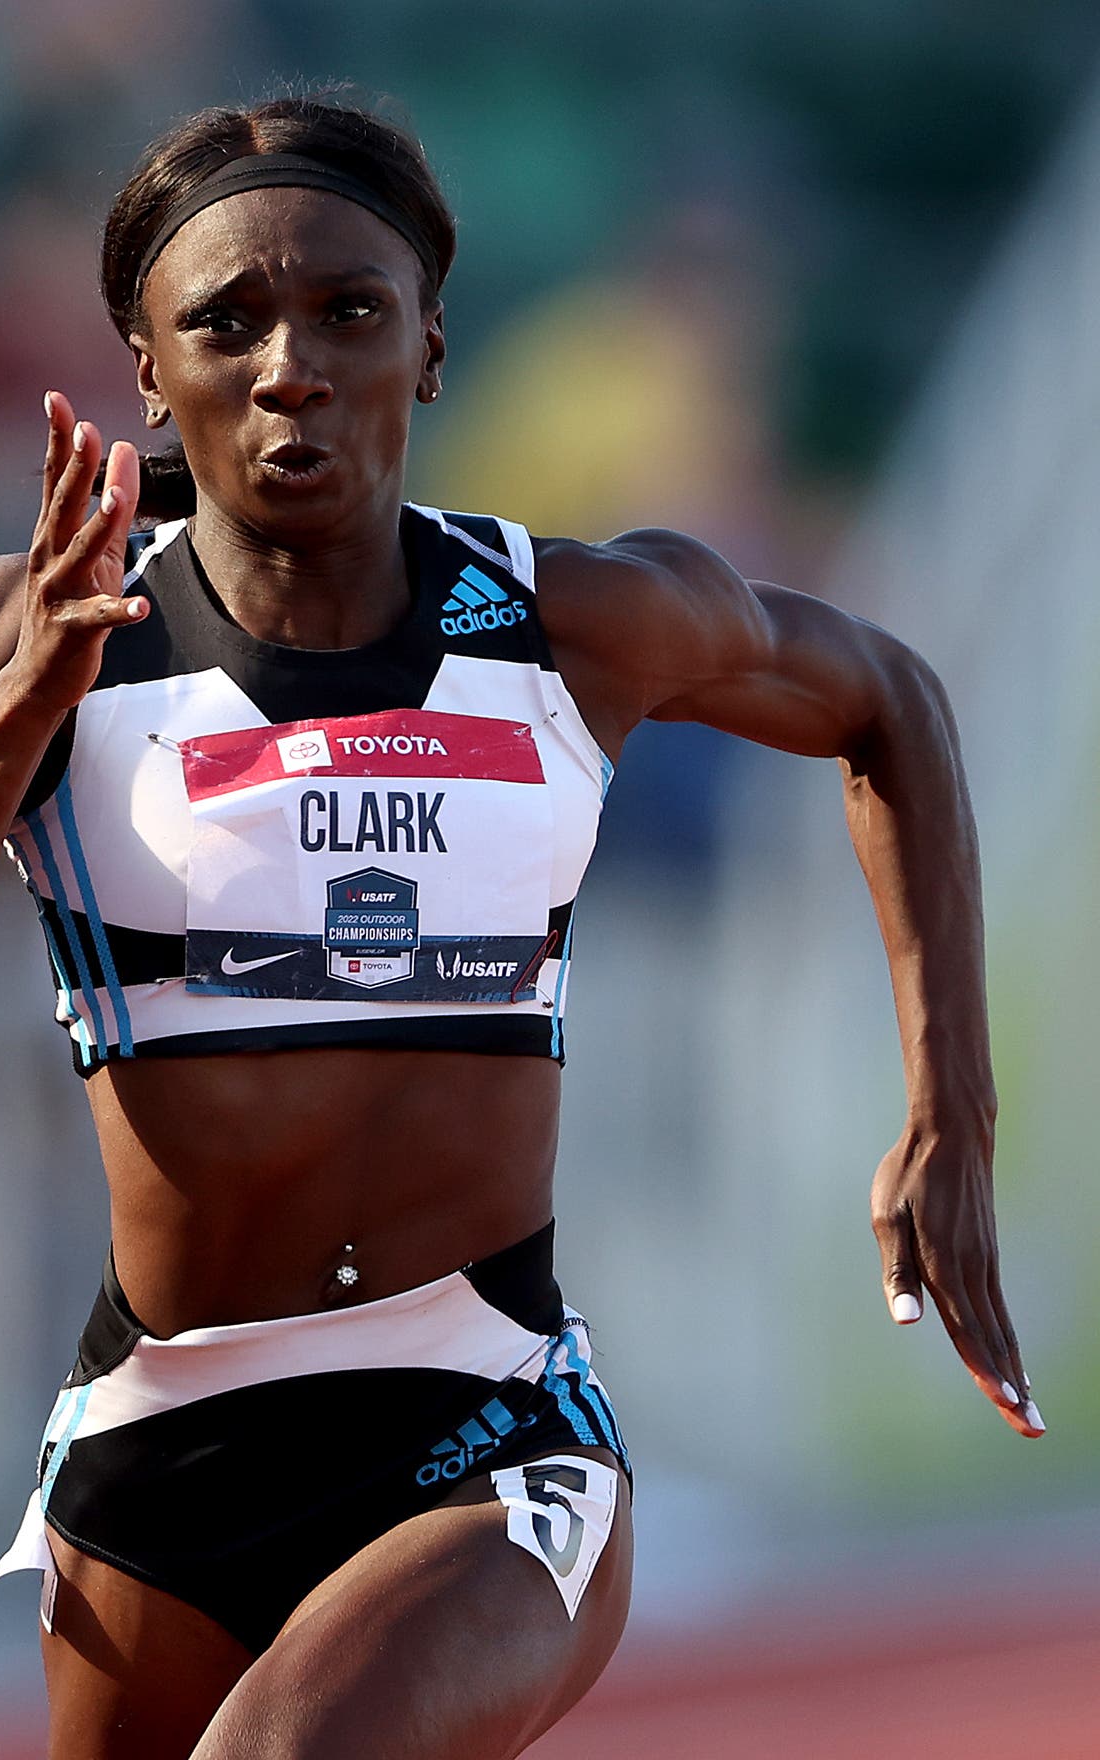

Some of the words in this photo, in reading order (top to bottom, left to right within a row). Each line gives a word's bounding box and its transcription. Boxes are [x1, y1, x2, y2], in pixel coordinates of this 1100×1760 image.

[440, 601, 527, 636] adidas
[336, 735, 448, 757] TOYOTA
[300, 790, 448, 853] CLARK
[361, 893, 397, 902] USATF
[337, 915, 359, 924] 2022
[360, 915, 406, 924] OUTDOOR
[328, 927, 414, 941] CHAMPIONSHIPS
[461, 961, 518, 978] USATF
[523, 1464, 587, 1579] 5
